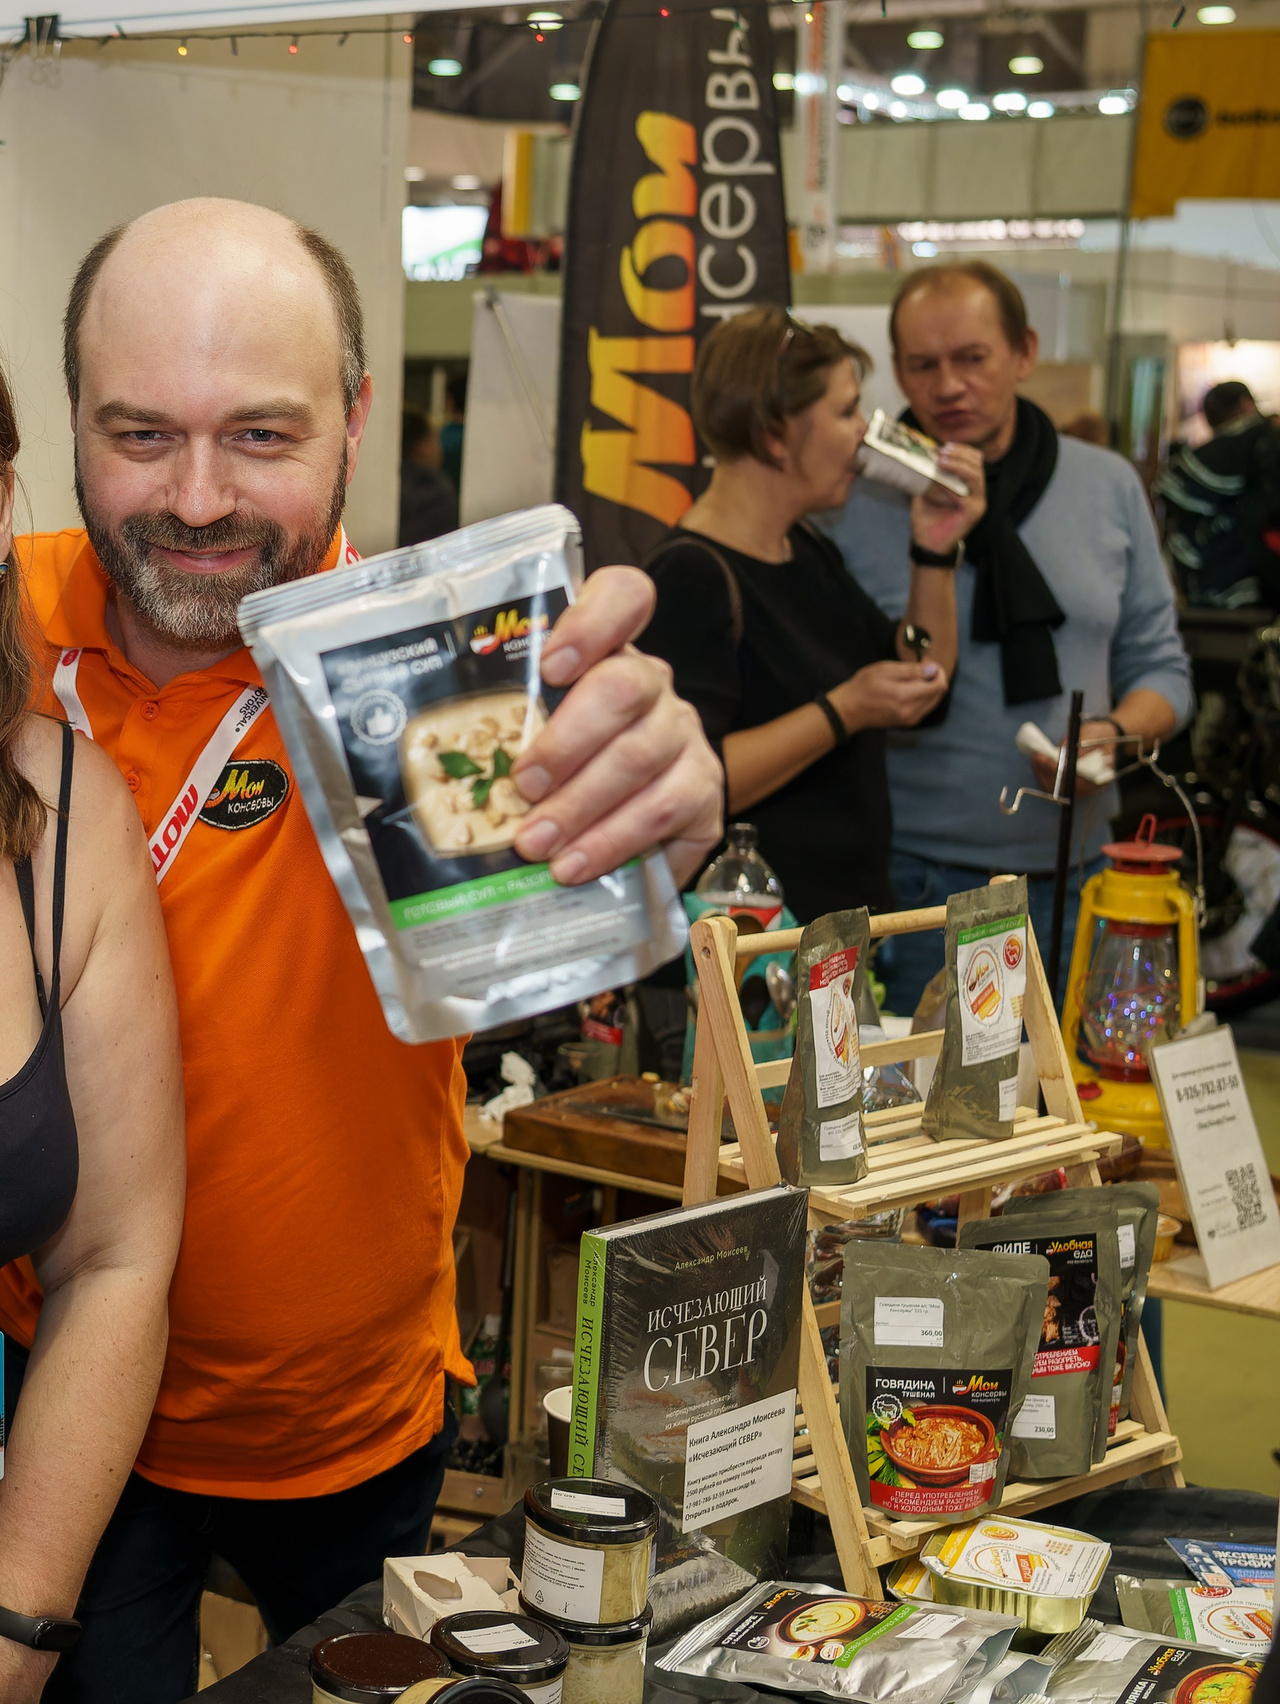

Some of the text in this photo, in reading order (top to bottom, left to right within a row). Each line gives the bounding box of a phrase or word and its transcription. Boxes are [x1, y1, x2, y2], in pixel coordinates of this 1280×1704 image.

[992, 1239, 1093, 1254] ФИЛЕ Удобная
[1073, 1248, 1093, 1259] еда
[675, 1245, 748, 1271] Александр Моисеев
[646, 1275, 768, 1334] ИСЧЕЗАЮЩИЙ
[920, 1329, 943, 1337] 360,00
[643, 1308, 768, 1392] СЕВЕР
[575, 1317, 594, 1447] ИСЧЕЗАЮЩИЙ
[875, 1375, 999, 1392] ГОВЯДИНА Мои
[902, 1390, 1007, 1399] ТУШЕНАЯ консервы
[688, 1407, 786, 1448] Книга Александра Моисеева
[701, 1472, 719, 1482] можно
[718, 1461, 746, 1476] приобрести
[767, 1447, 783, 1458] автору
[686, 1488, 698, 1498] 2500
[698, 1482, 716, 1494] рублей
[722, 1474, 740, 1485] номеру
[740, 1464, 763, 1478] телефона
[725, 1482, 749, 1496] Александр
[895, 1488, 979, 1500] ПЕРЕД УПОТРЕБЛЕНИЕМ
[890, 1496, 945, 1506] РЕКОМЕНДУЕМ
[900, 1504, 943, 1513] ХОЛОДНЫМ
[945, 1504, 963, 1512] ТОЖЕ
[684, 1508, 711, 1521] Открытка
